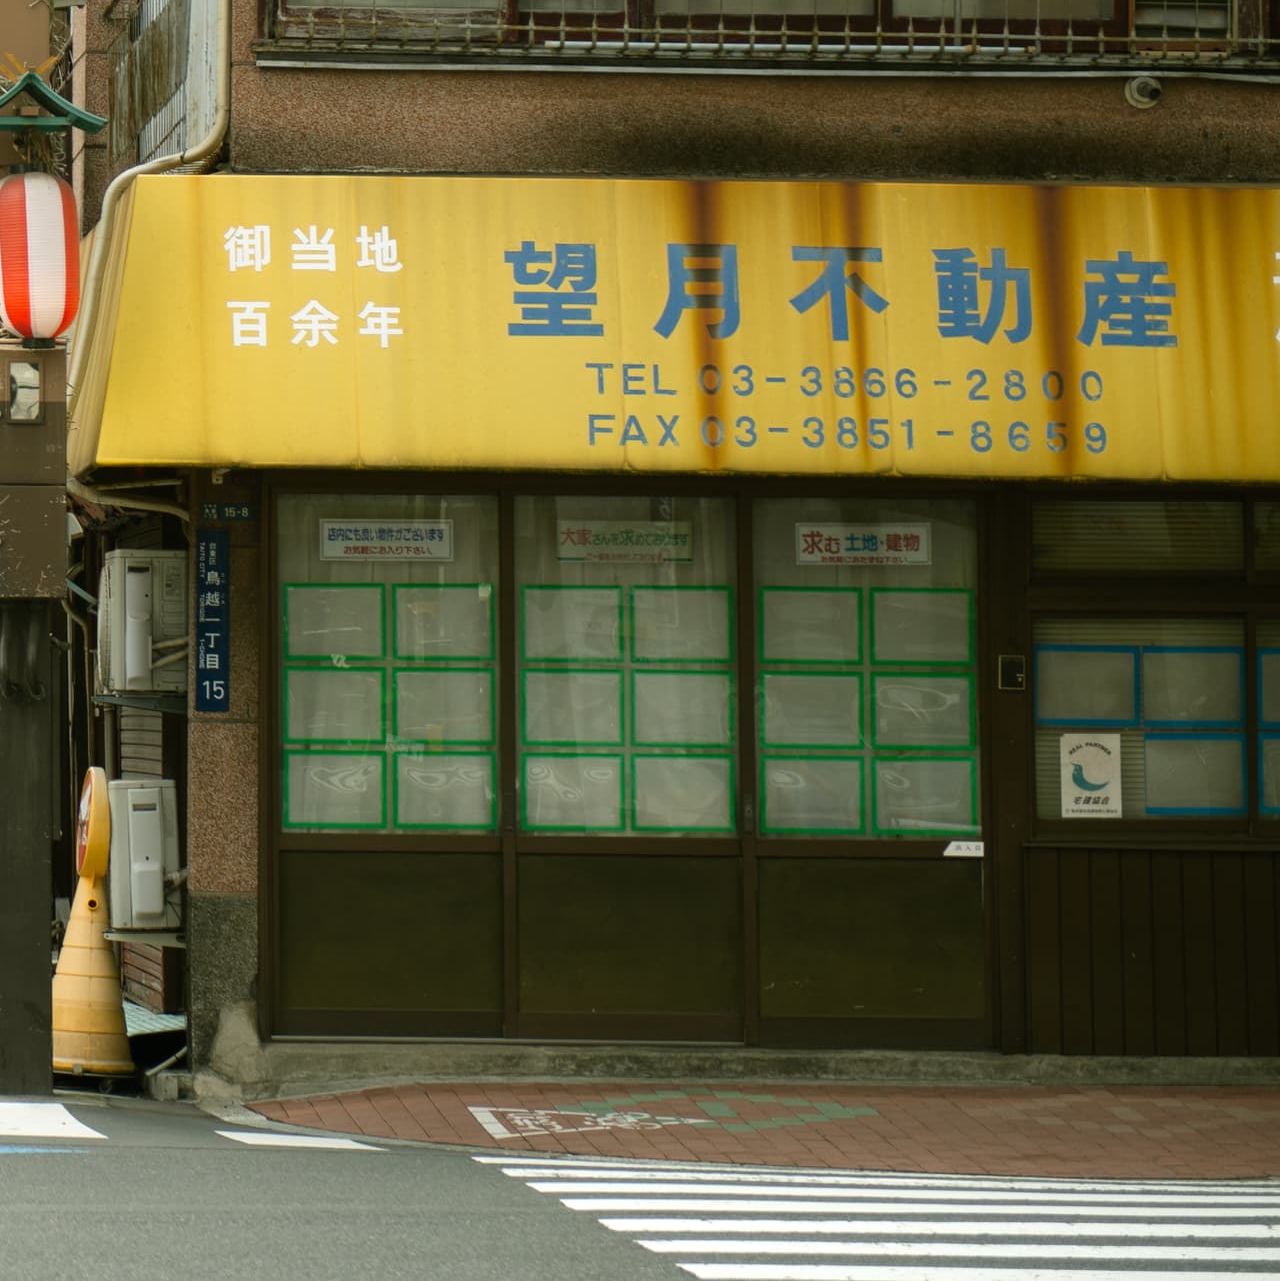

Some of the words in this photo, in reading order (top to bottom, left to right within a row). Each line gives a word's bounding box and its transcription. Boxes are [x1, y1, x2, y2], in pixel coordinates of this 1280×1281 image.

[224, 225, 404, 272] 御当地
[505, 241, 1177, 349] 望月不動産
[227, 301, 404, 348] 百余年
[585, 364, 677, 396] TEL
[701, 363, 1106, 402] 03-3866-2800
[588, 415, 681, 447] FAX
[701, 415, 1109, 455] 03-3851-8659
[224, 507, 249, 518] 15-8
[205, 570, 221, 669] 鳥越一丁目
[203, 681, 224, 700] 15
